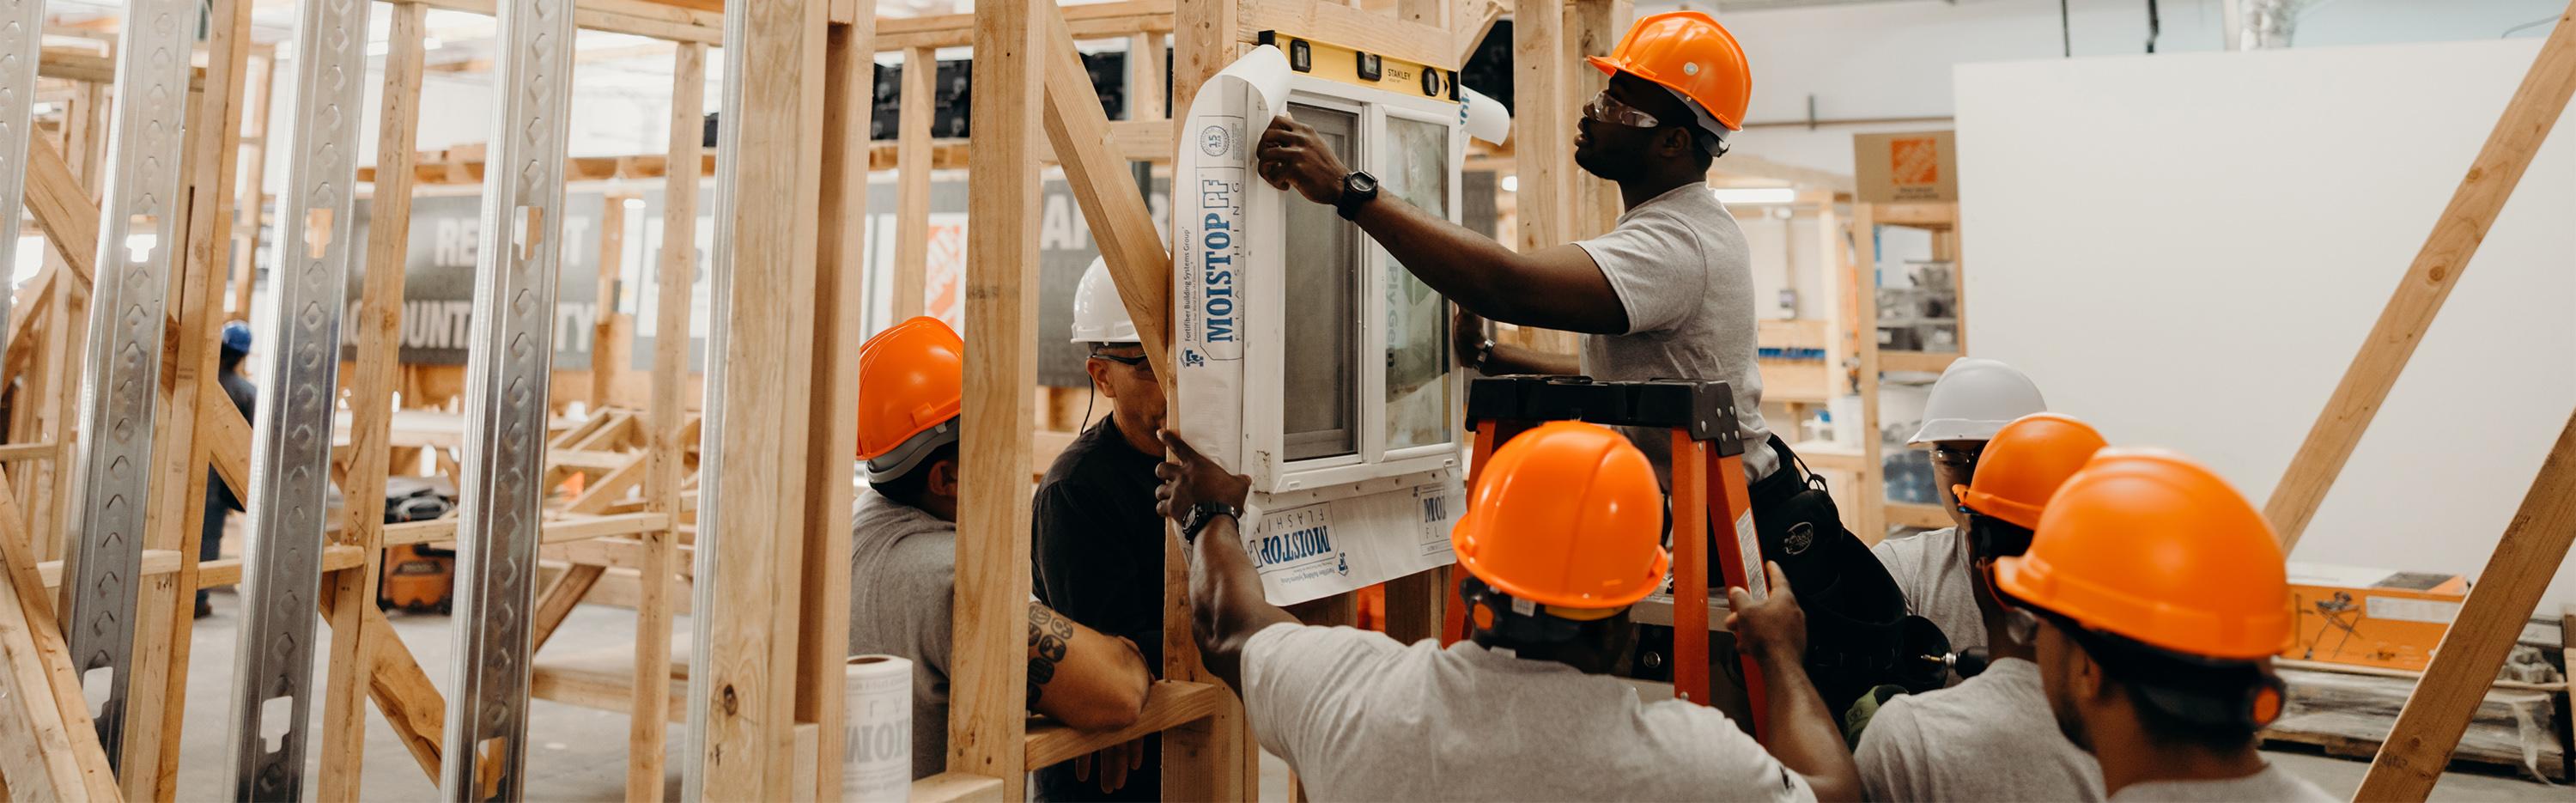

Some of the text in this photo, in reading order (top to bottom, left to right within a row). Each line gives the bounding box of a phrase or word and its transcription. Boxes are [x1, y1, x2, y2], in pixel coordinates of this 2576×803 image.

[1388, 68, 1411, 81] STANLEY
[1208, 134, 1218, 149] 15
[1183, 252, 1192, 280] Systems
[1202, 179, 1233, 343] MOISTOP PF
[1386, 266, 1399, 306] Ply
[1261, 526, 1331, 564] MOISTOP
